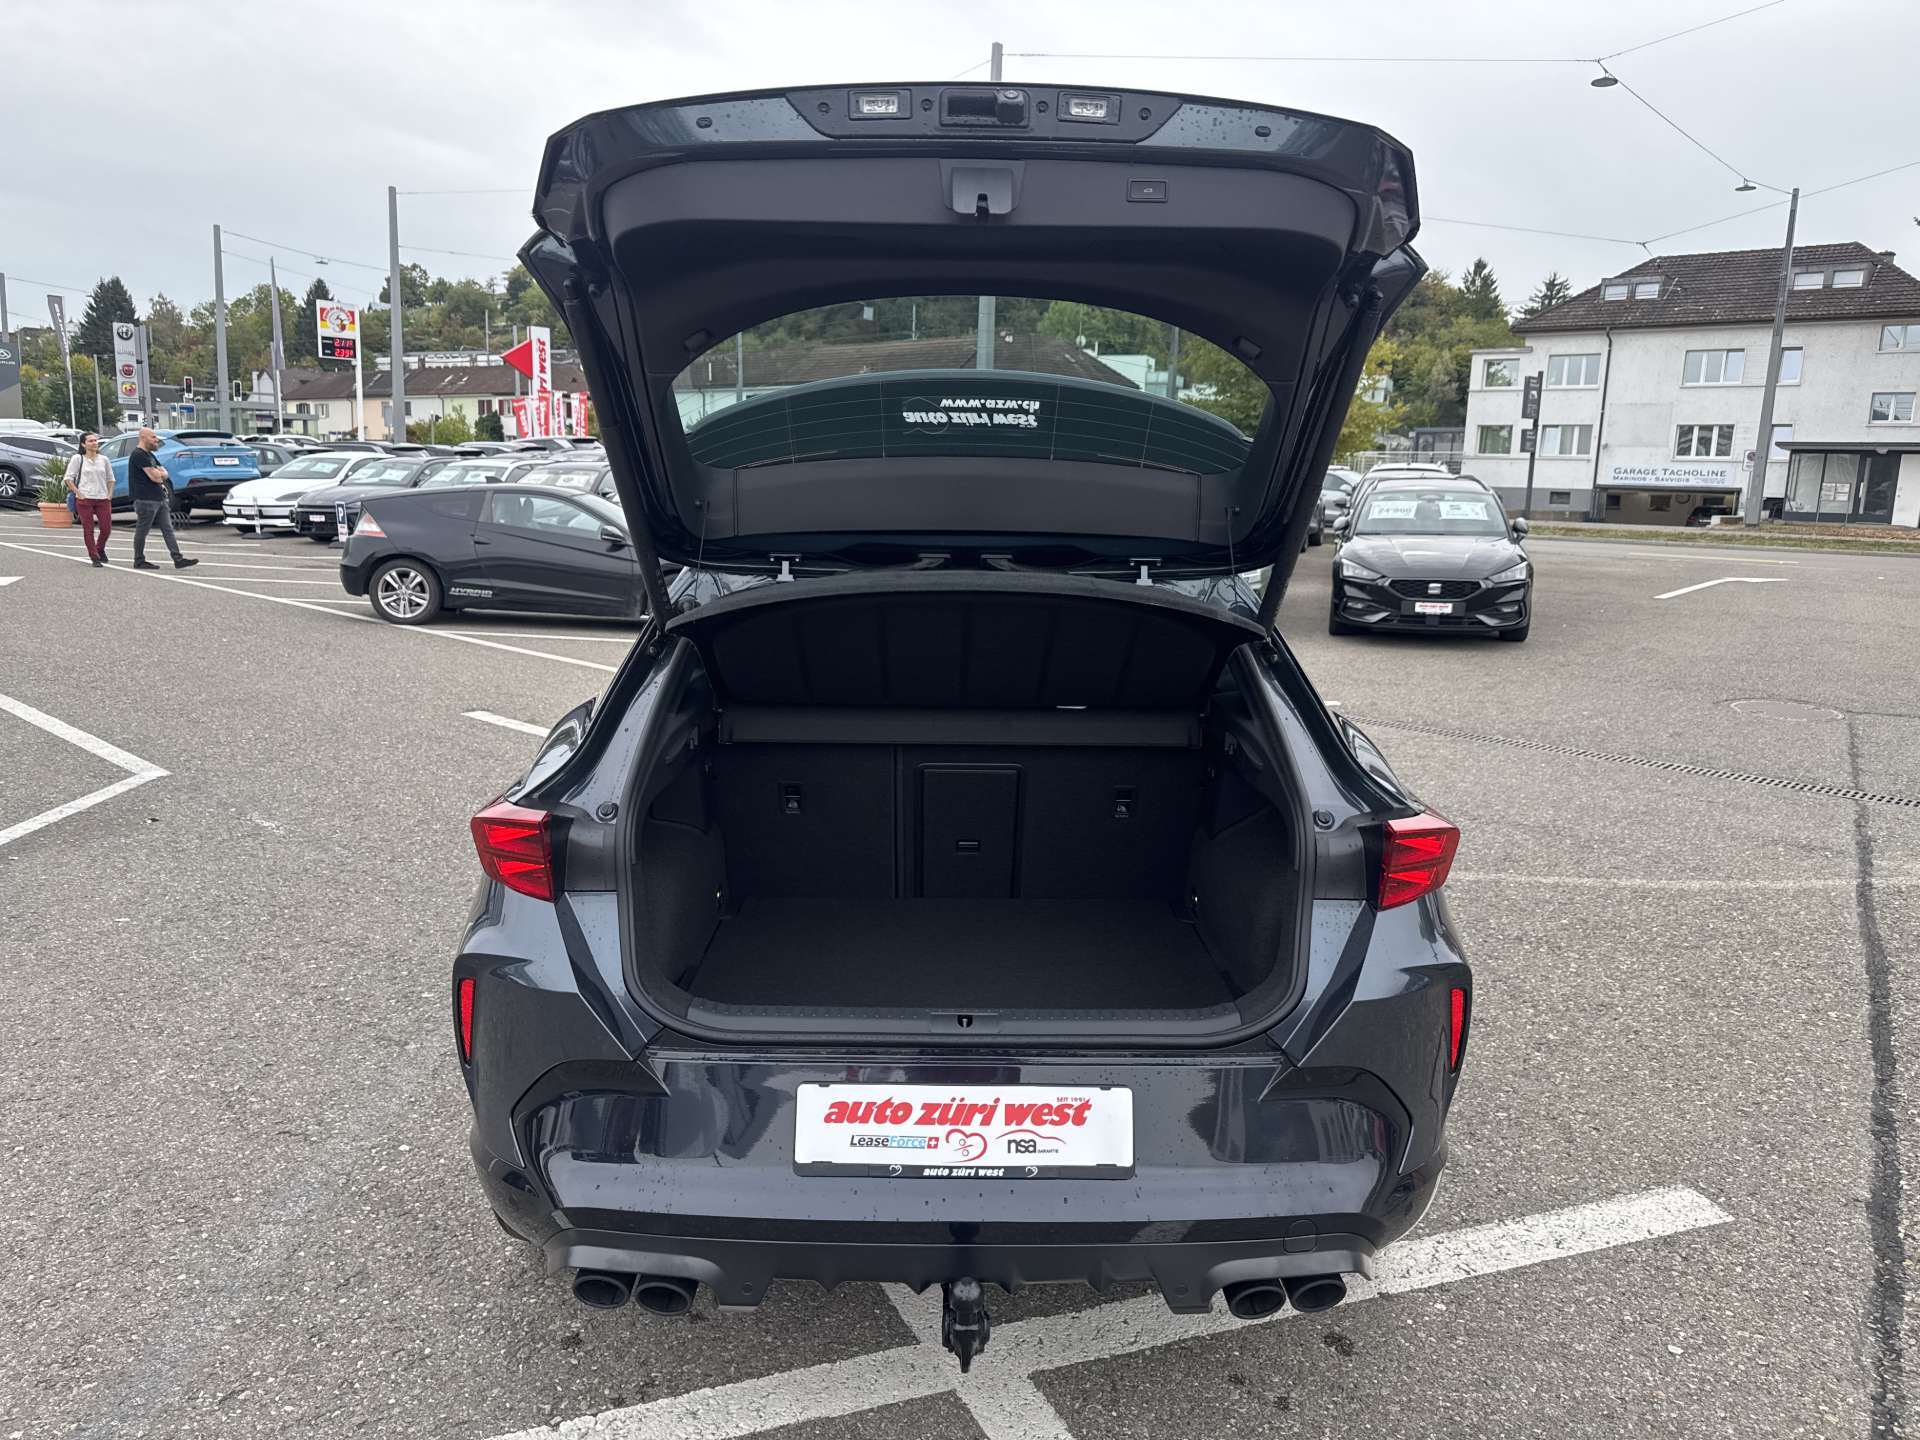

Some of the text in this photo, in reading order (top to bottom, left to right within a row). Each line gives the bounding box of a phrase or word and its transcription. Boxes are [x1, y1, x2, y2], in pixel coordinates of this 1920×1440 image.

[1614, 467, 1727, 477] GARAGE TACHOLINE
[823, 1097, 1092, 1127] auto züri west
[850, 1134, 926, 1148] LeaseForce
[1007, 1139, 1036, 1154] nsa
[922, 1167, 1005, 1177] auto züri west
